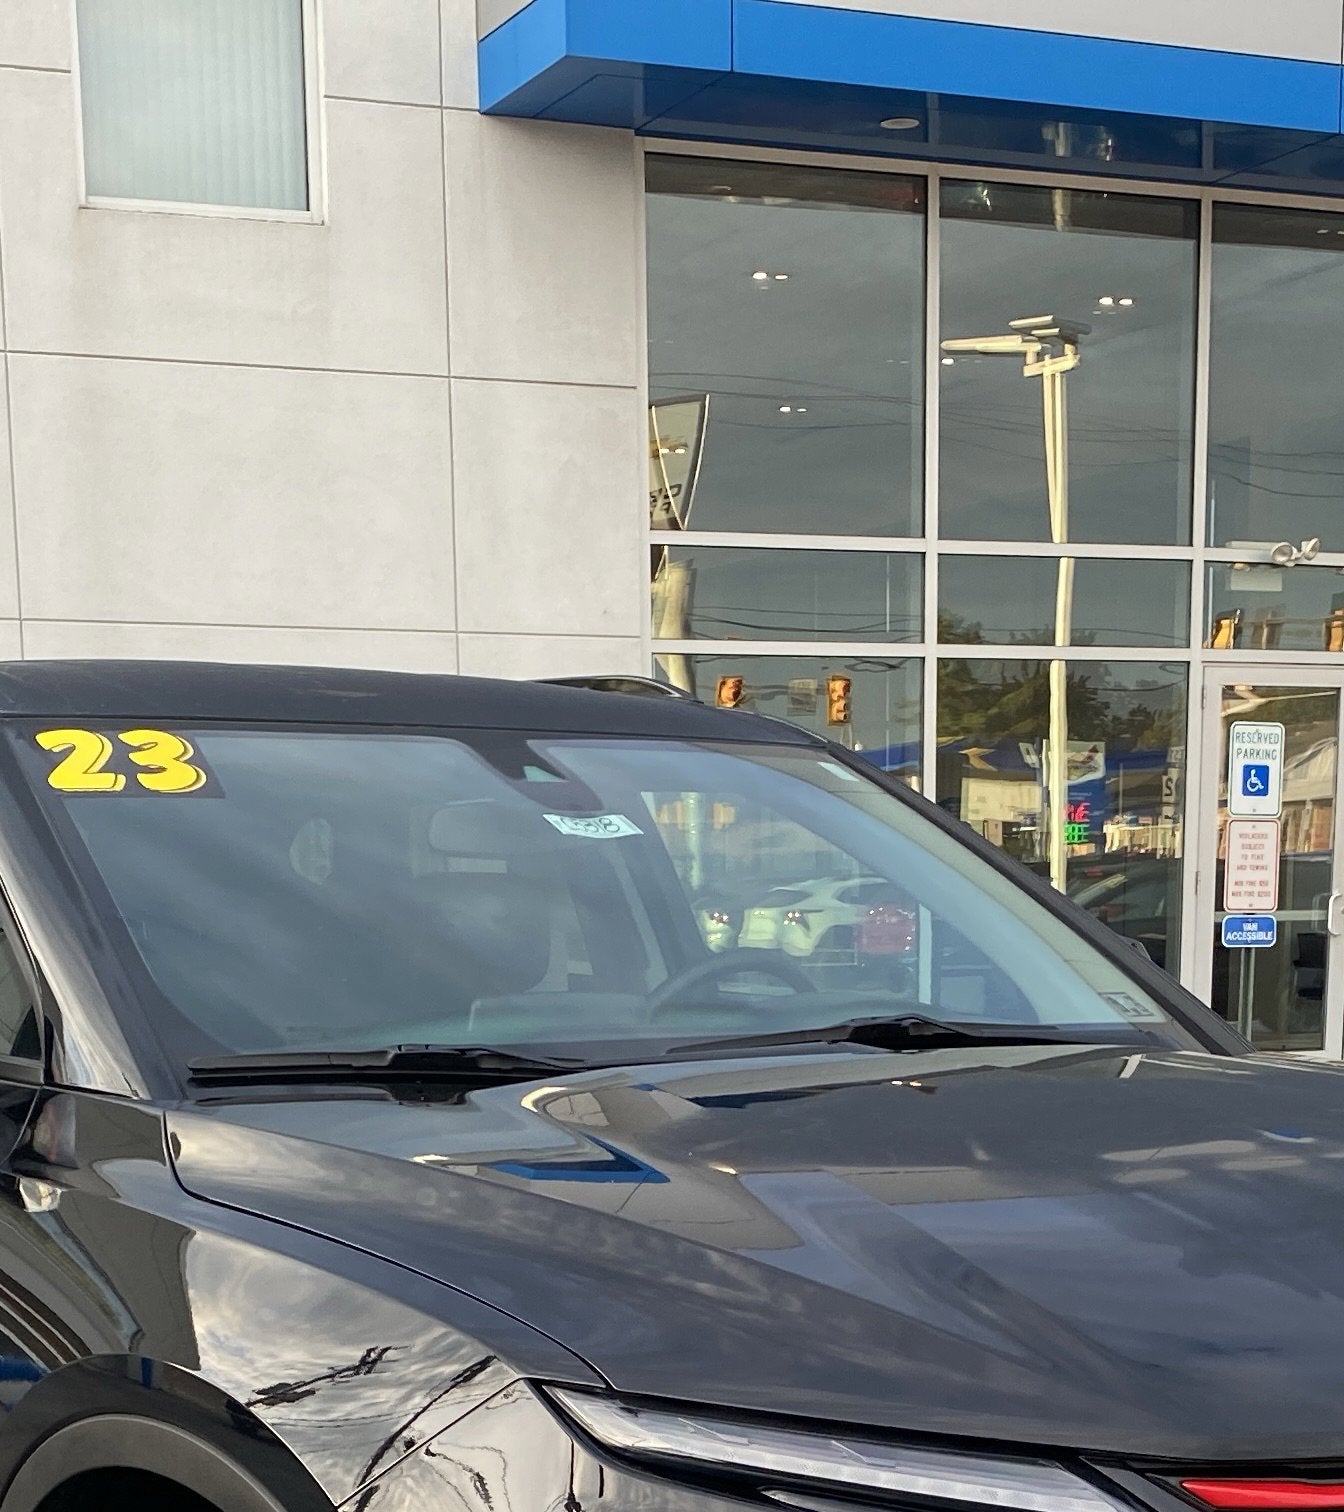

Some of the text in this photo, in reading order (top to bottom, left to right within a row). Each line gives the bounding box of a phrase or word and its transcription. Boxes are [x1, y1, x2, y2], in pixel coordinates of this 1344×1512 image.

[1235, 731, 1280, 744] RESERVED
[1236, 747, 1278, 760] PARKING
[34, 728, 207, 793] 23
[1242, 922, 1259, 932] VAN
[1225, 931, 1274, 941] ACCESSIBLE
